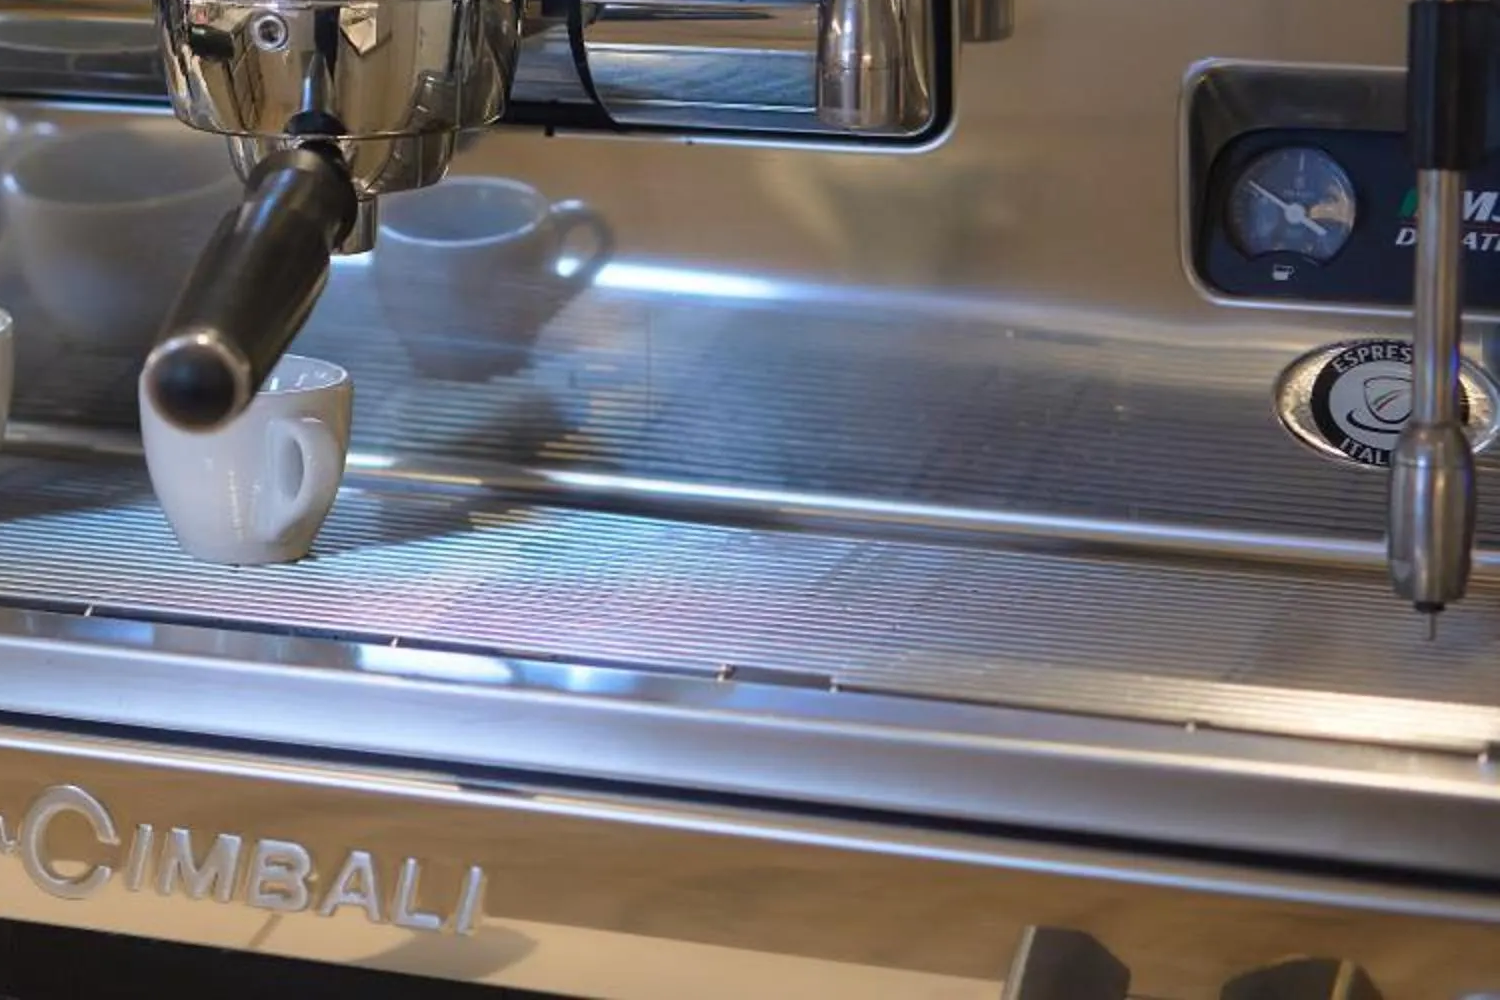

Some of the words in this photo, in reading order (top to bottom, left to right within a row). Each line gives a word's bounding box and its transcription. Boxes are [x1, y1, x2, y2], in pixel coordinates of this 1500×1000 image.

[1463, 190, 1500, 222] M
[1331, 345, 1414, 373] ESPRES
[1338, 437, 1387, 466] ITAL
[21, 784, 486, 935] CIMBALI
